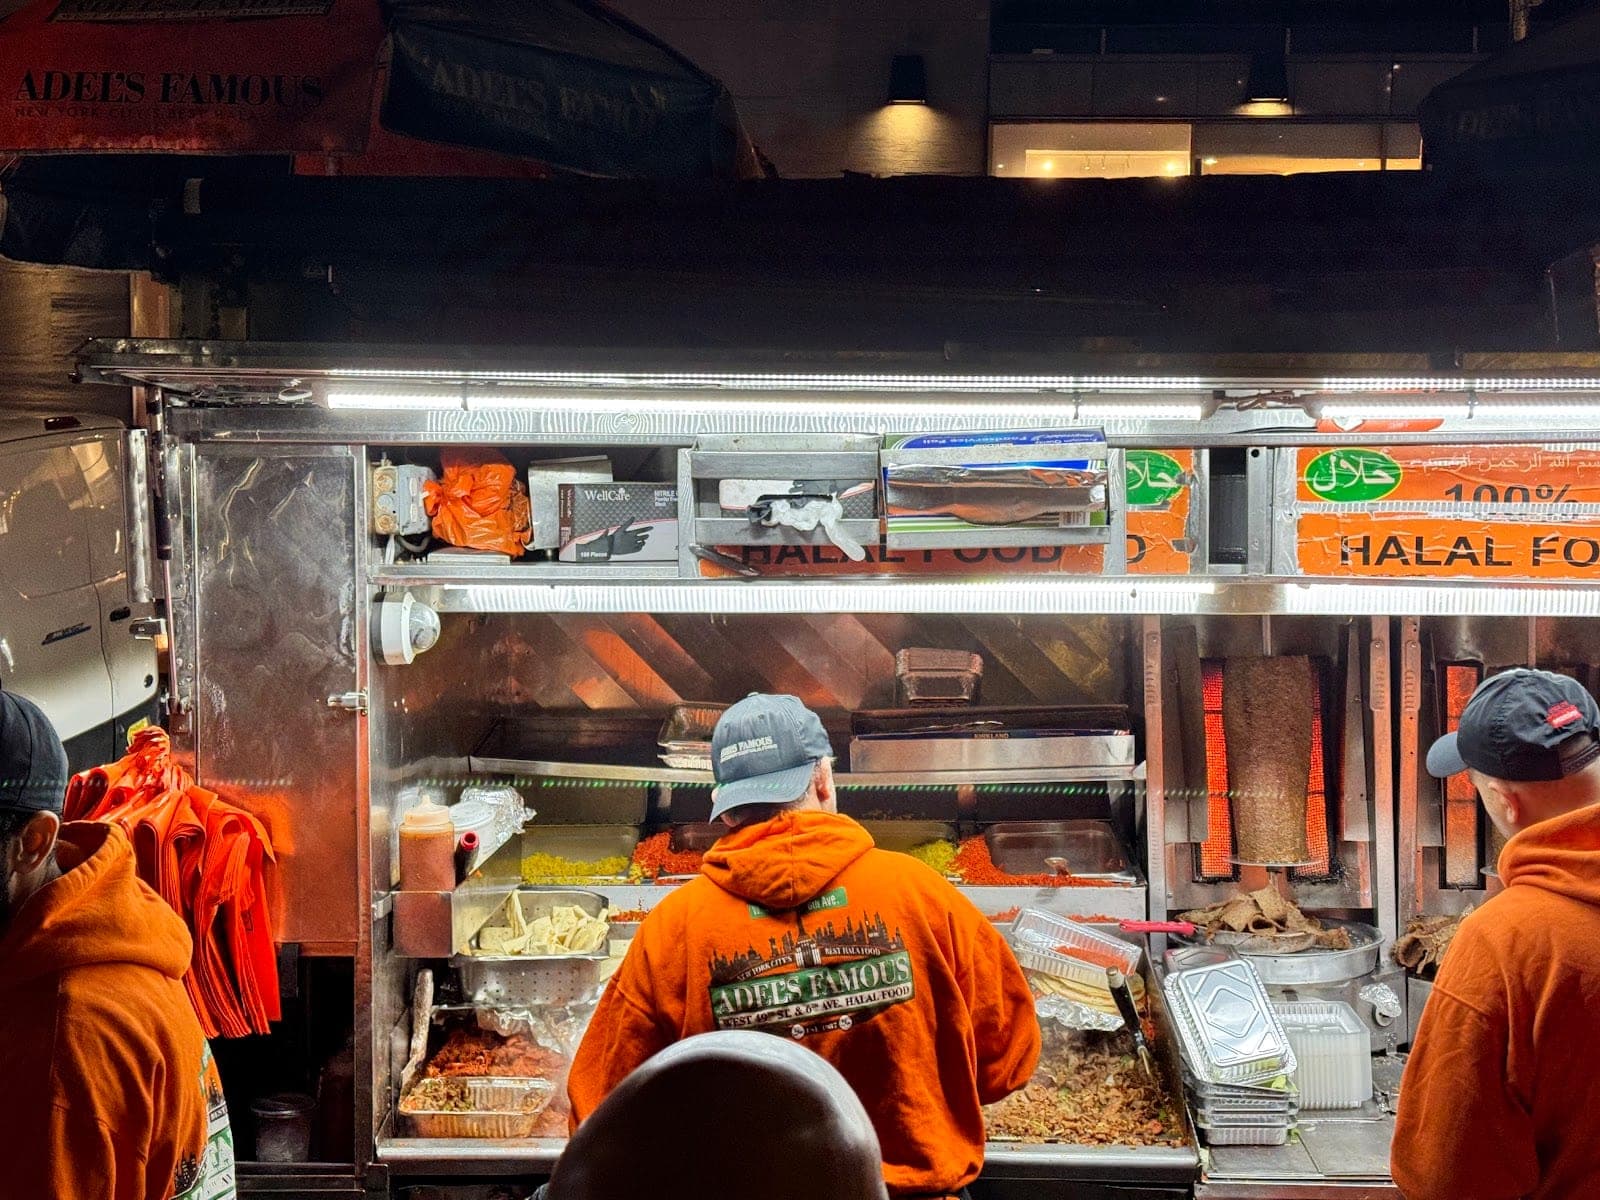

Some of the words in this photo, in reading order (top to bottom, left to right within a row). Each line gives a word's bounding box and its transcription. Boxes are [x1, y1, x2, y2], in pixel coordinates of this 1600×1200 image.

[16, 69, 146, 103] ADEL'S
[160, 72, 323, 108] FAMOUS
[1126, 456, 1179, 491] حلا
[584, 488, 631, 501] WellCare
[1340, 535, 1513, 566] HALAL
[821, 895, 840, 908] Ave.
[716, 975, 802, 1014] ADEL'S
[808, 956, 910, 998] FAMOUS
[845, 993, 880, 1006] HALAL
[881, 985, 910, 999] FOOD
